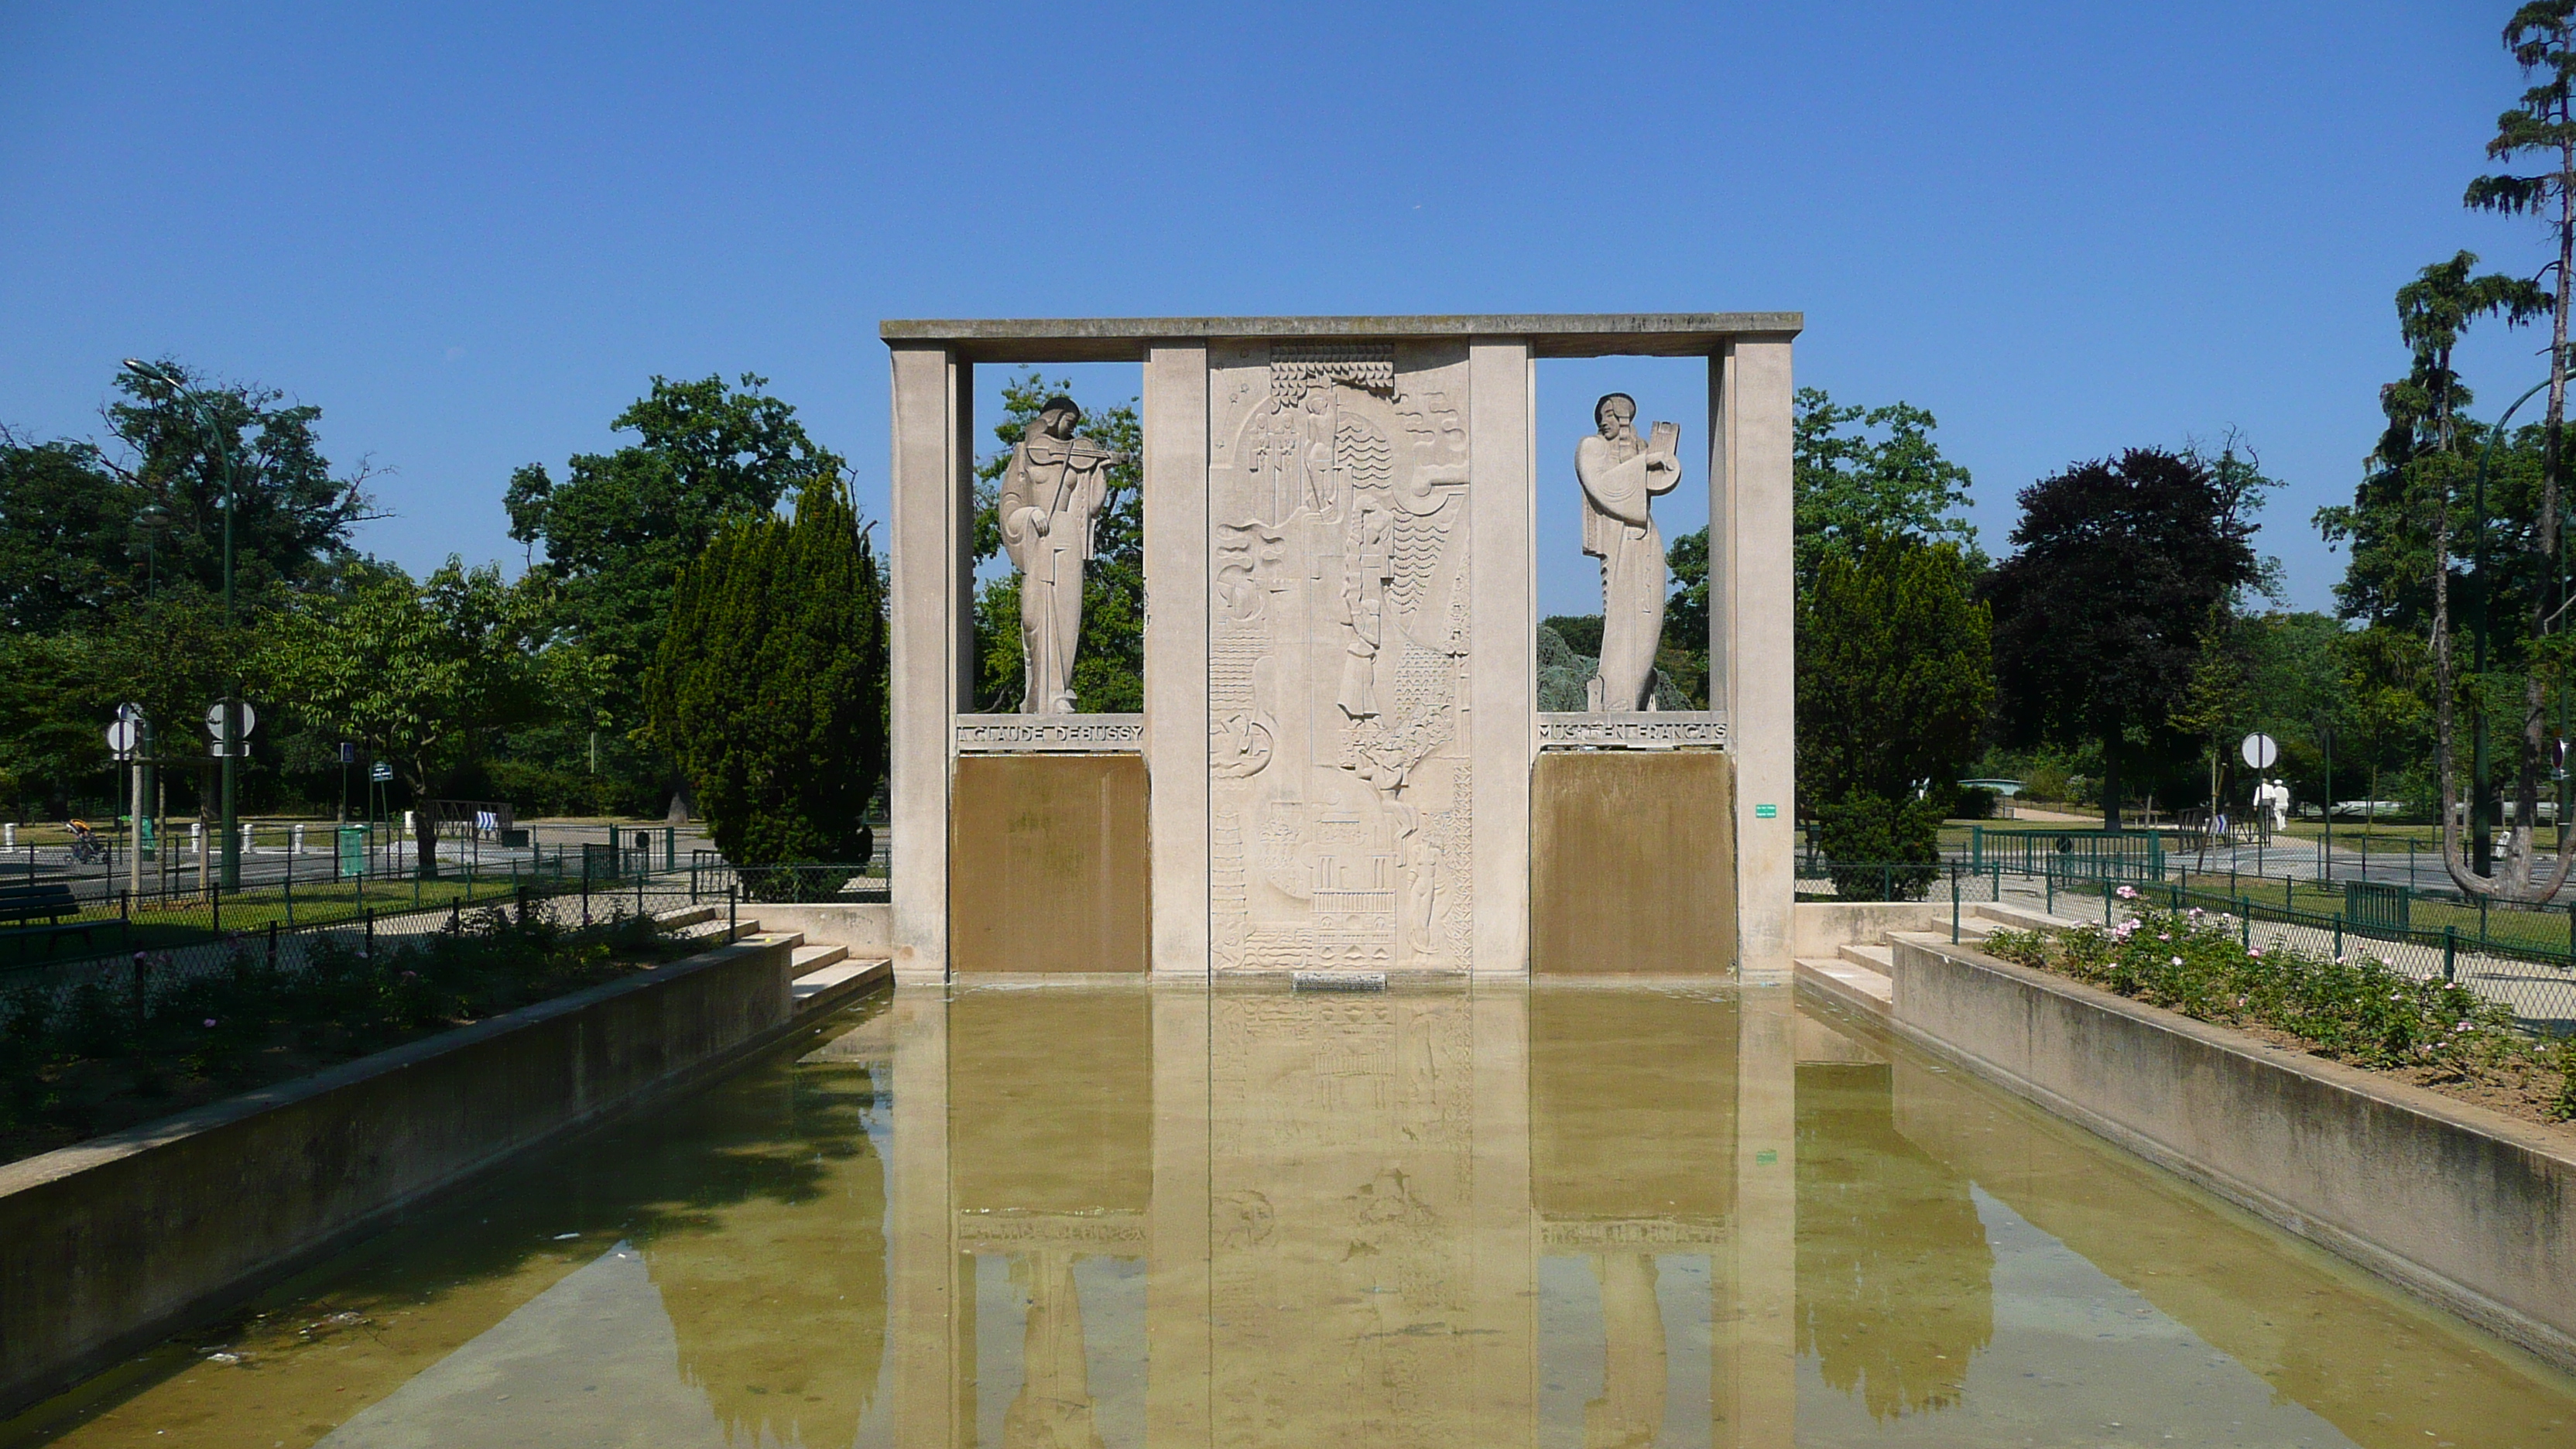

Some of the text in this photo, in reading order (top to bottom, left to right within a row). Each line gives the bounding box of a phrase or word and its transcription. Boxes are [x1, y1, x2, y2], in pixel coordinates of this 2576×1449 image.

[957, 726, 1144, 741] A CLAUDE DEBUSSY
[1538, 723, 1626, 740] MUSICIEN
